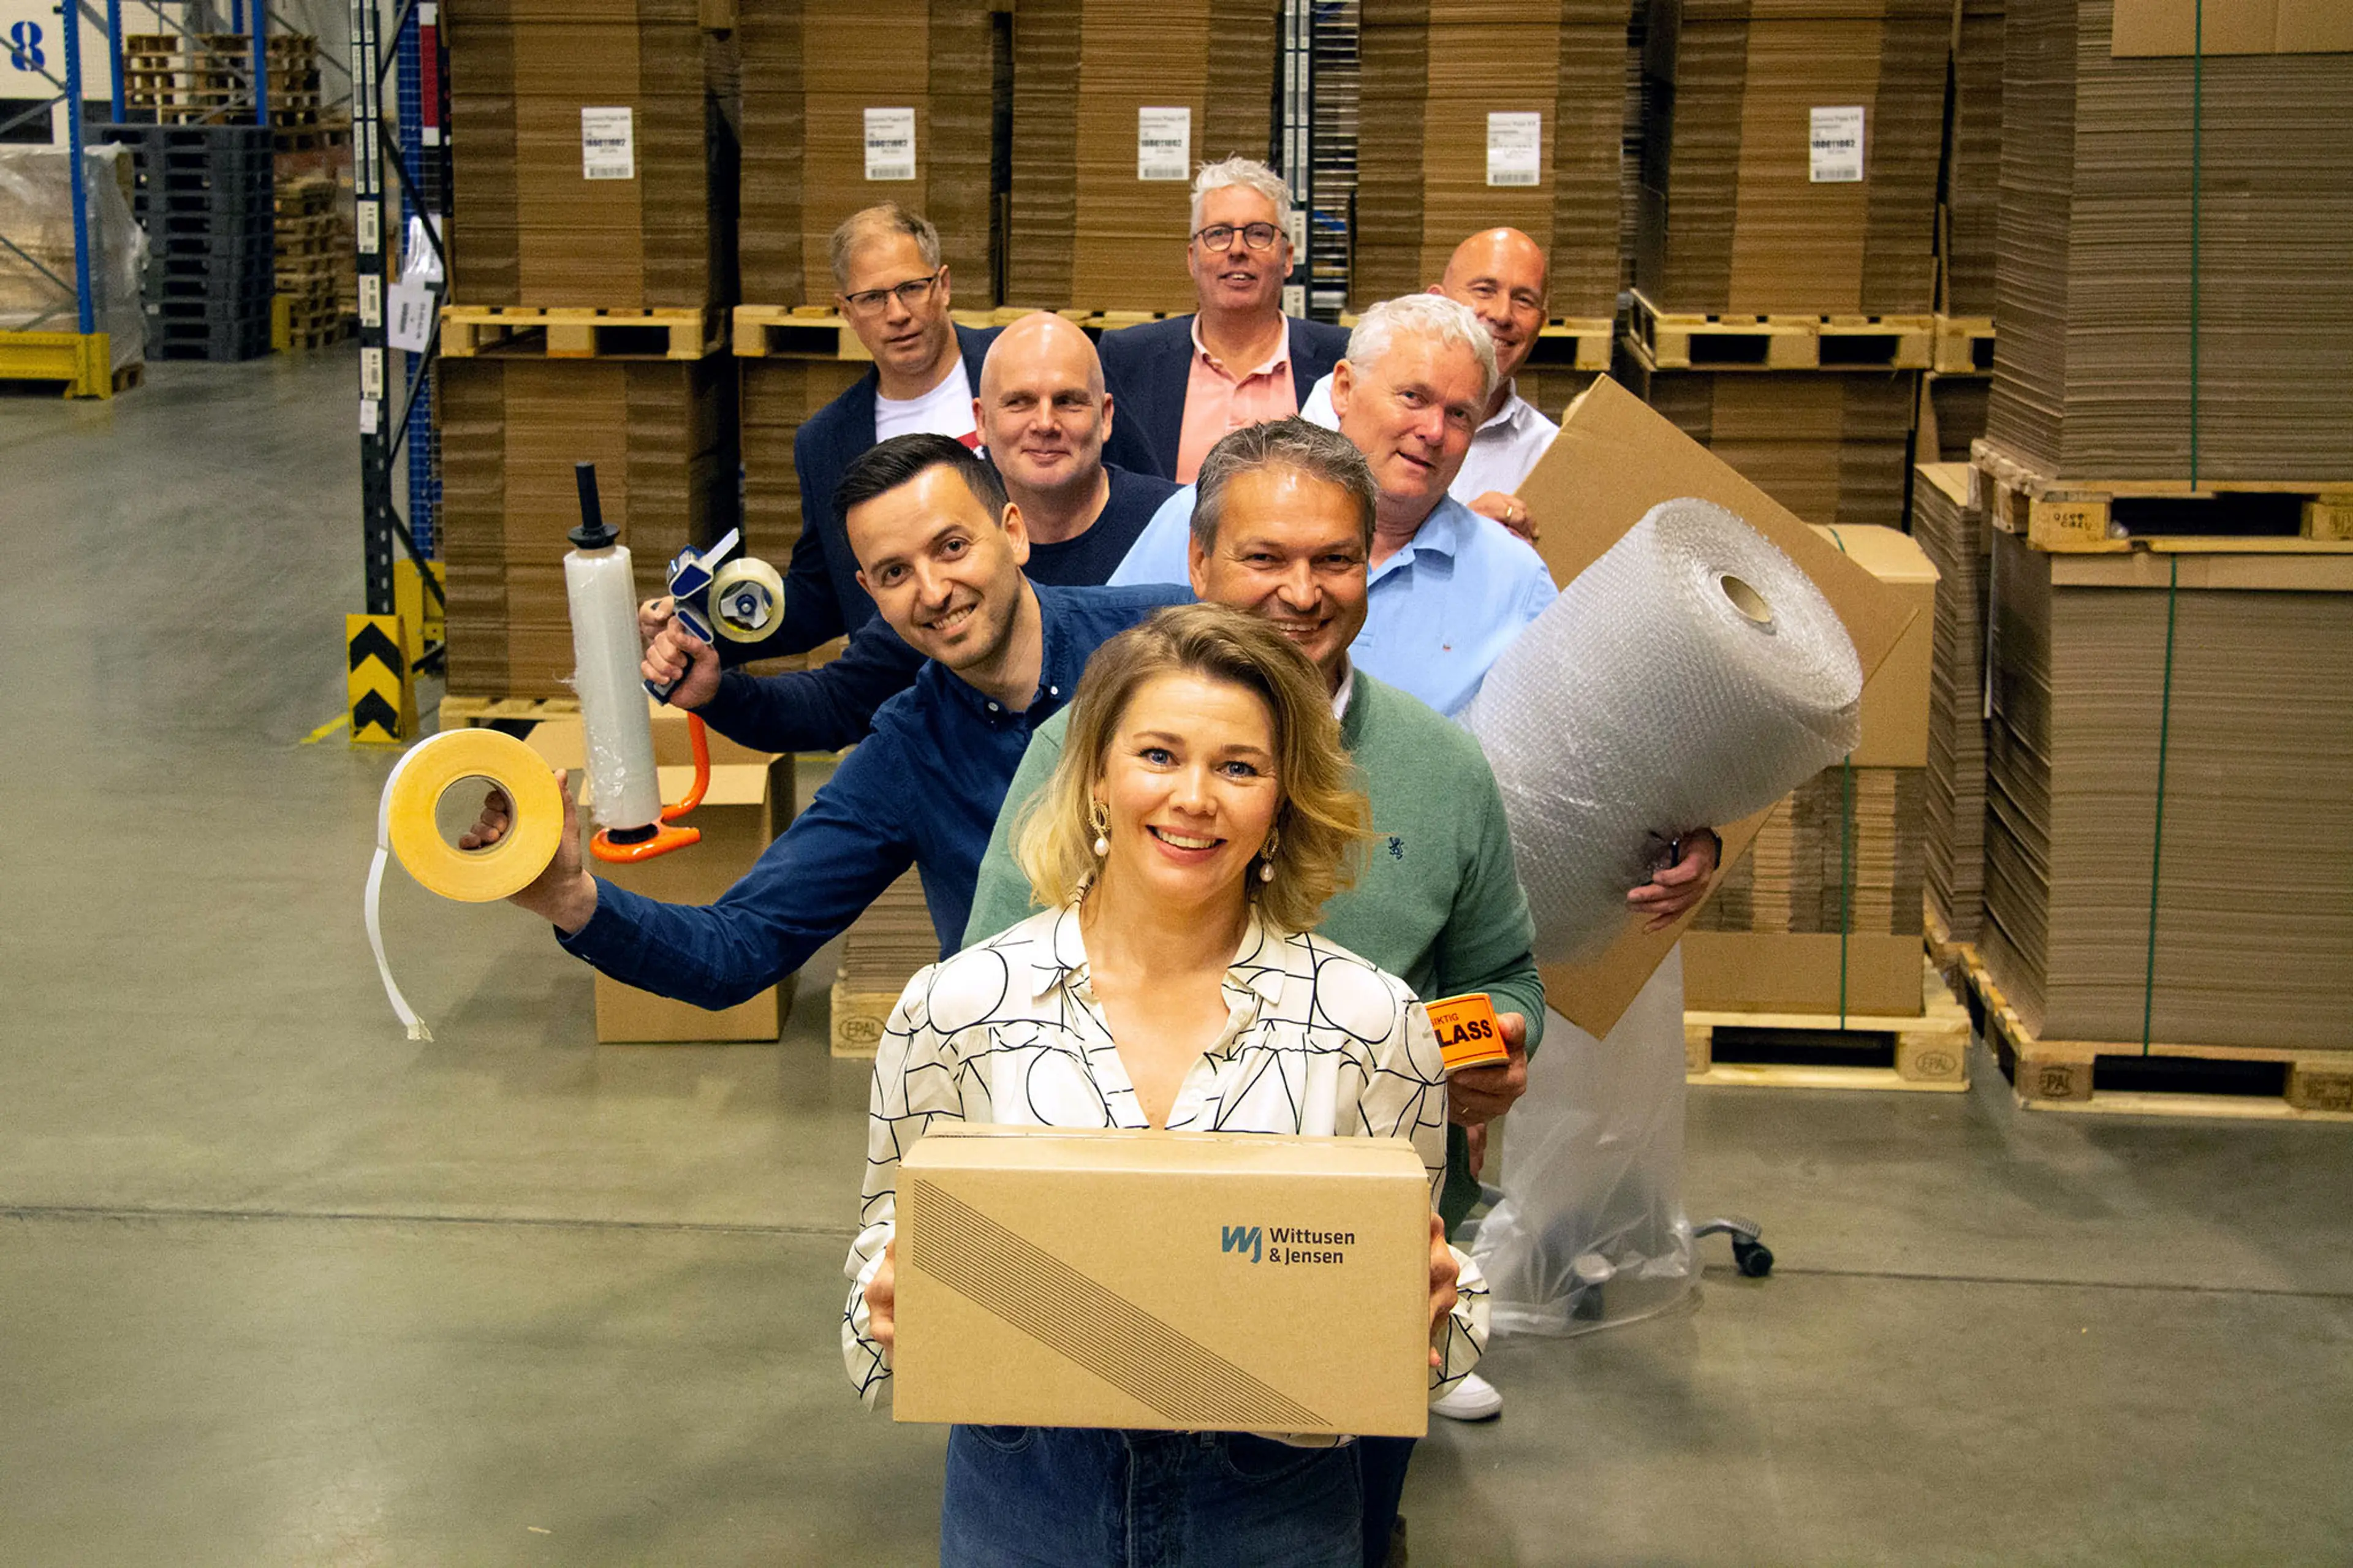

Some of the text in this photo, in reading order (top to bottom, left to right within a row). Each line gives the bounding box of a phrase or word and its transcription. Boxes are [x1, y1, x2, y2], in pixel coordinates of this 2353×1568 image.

[10, 20, 45, 72] 8
[1269, 1227, 1355, 1245] Wittusen
[1269, 1247, 1343, 1265] & Jensen
